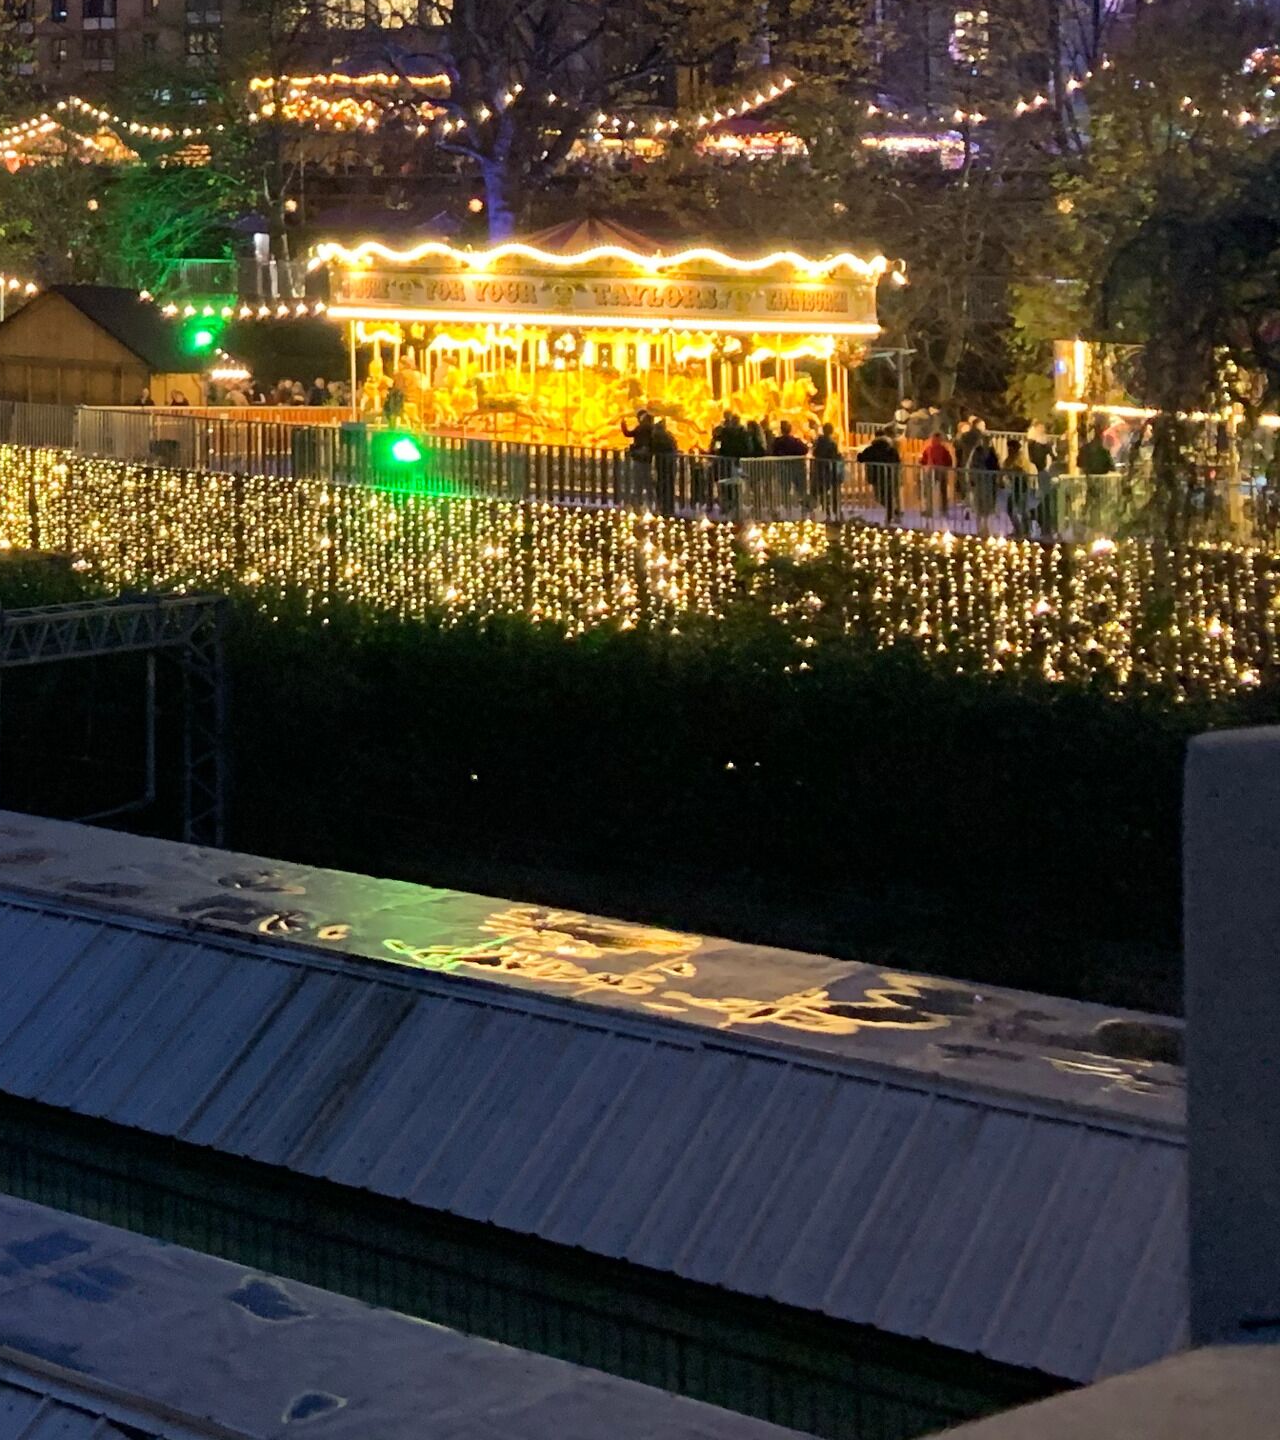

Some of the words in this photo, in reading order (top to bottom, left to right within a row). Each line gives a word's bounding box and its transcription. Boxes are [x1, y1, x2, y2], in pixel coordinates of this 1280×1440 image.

[424, 278, 466, 301] FOR
[472, 280, 538, 305] YOUR
[593, 283, 718, 309] TAYLORS
